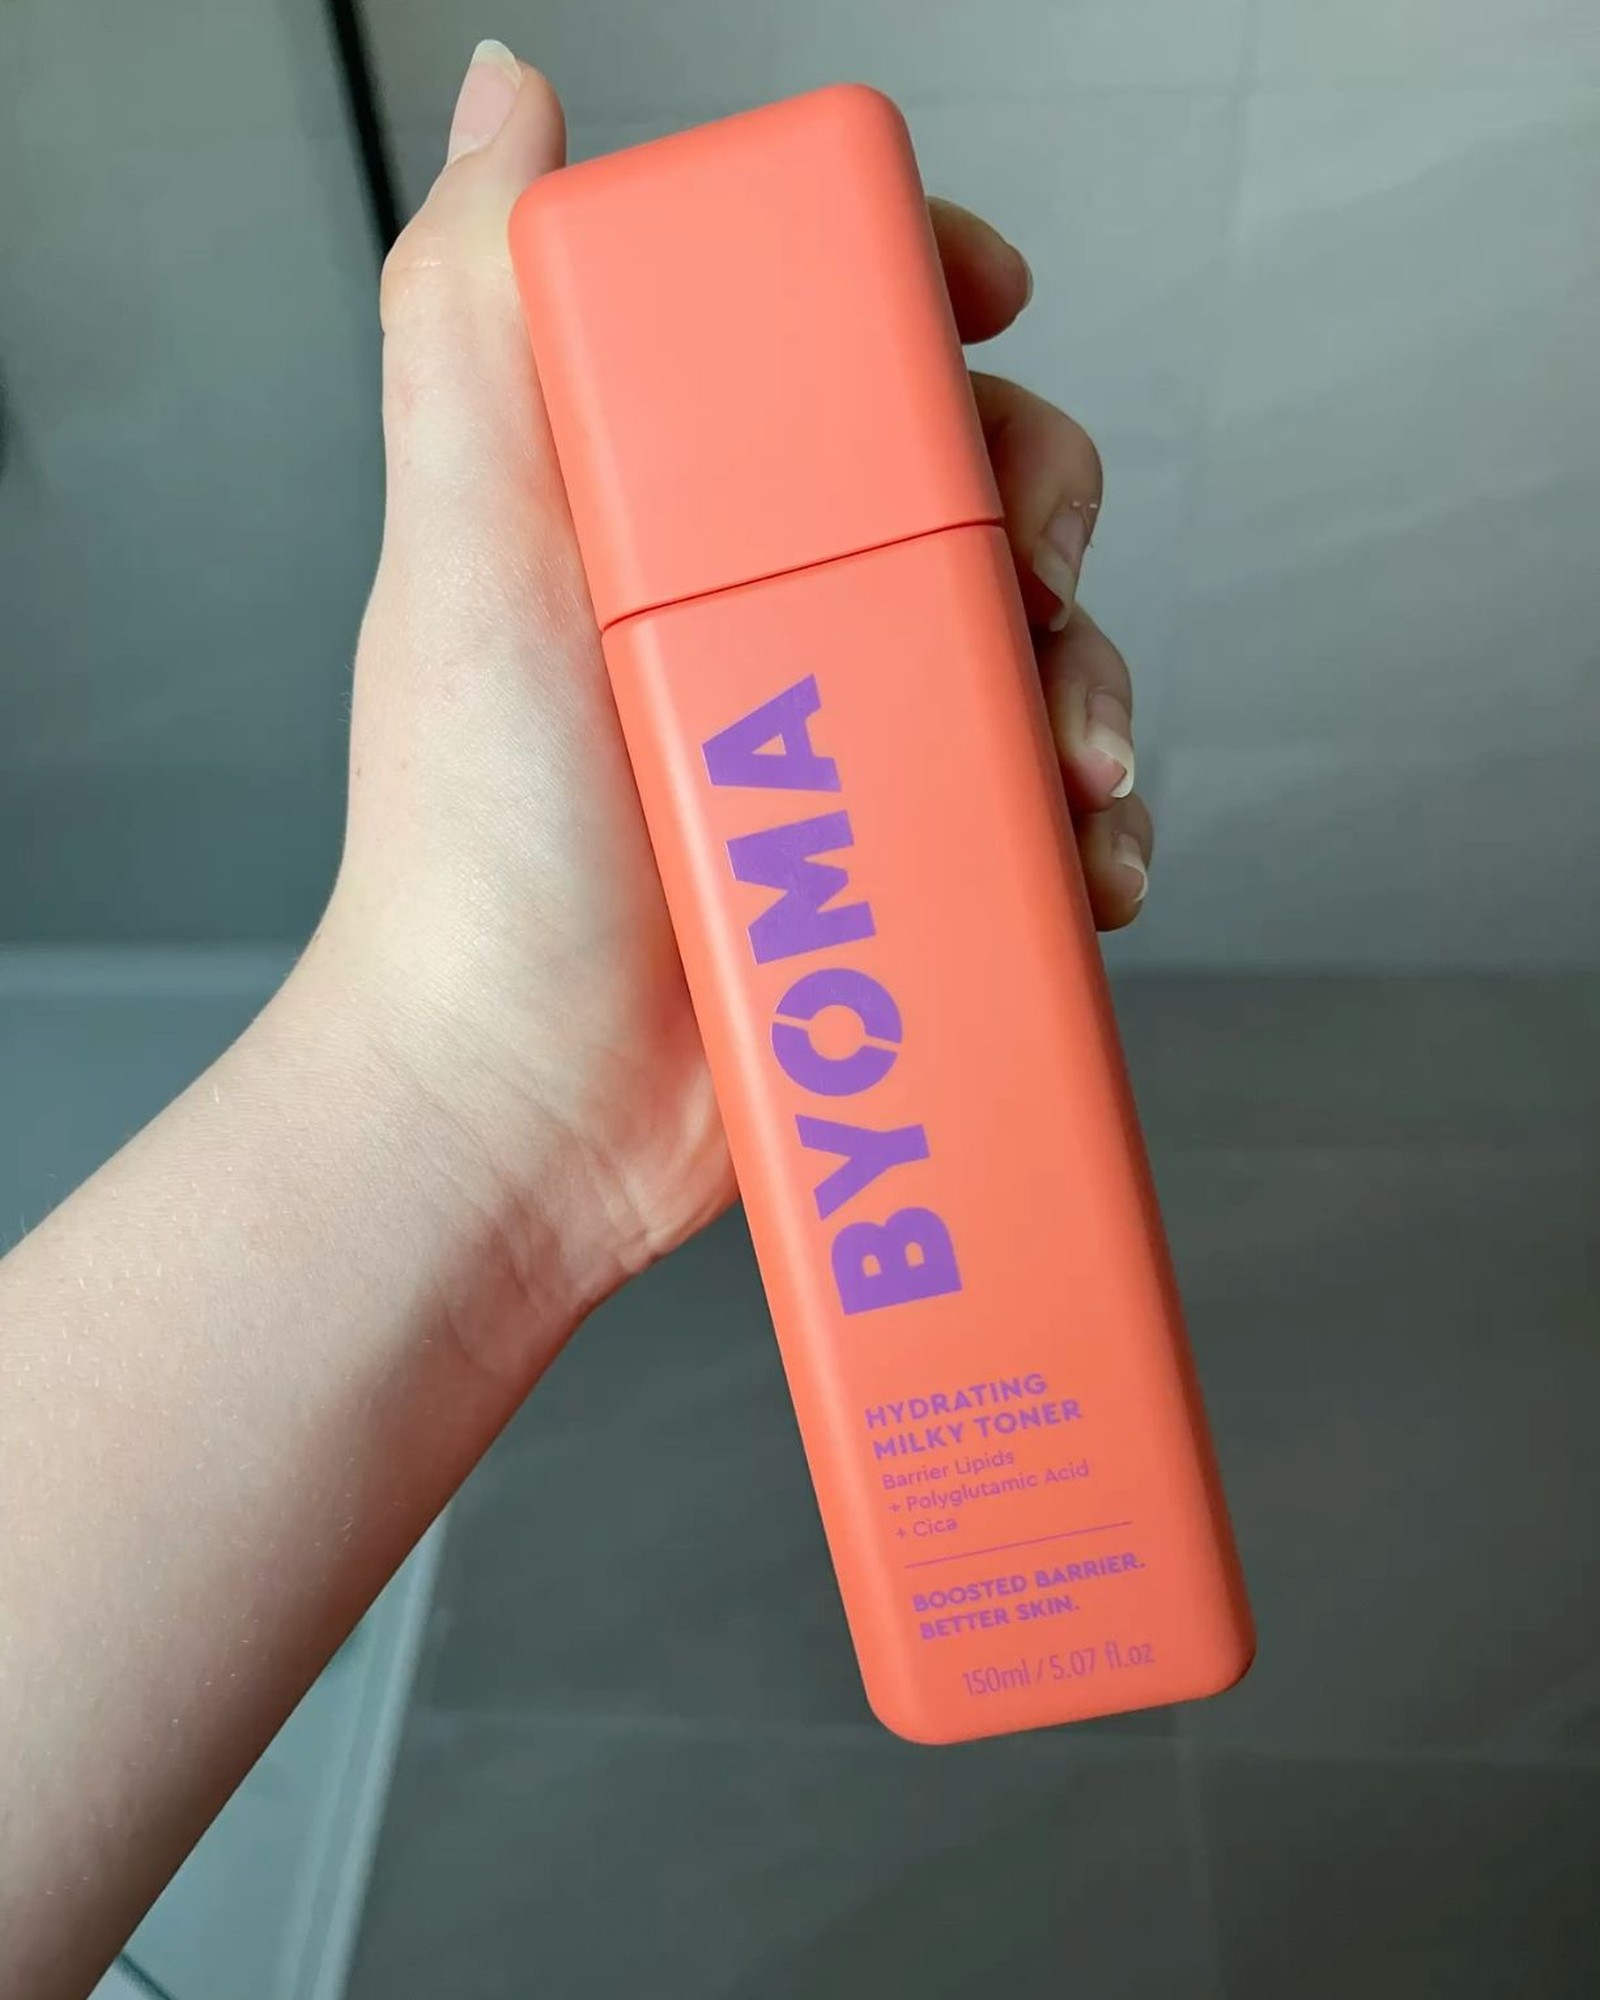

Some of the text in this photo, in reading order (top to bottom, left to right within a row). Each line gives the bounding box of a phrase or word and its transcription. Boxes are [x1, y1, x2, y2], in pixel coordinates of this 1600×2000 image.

[702, 673, 962, 1316] BYOMA
[865, 1373, 1047, 1429] HYDRATING
[872, 1399, 1083, 1461] MILKY TONER
[882, 1450, 1014, 1490] Barrier Lipids
[888, 1459, 1089, 1513] + Polyglutamic Acid
[895, 1517, 958, 1538] + Cica
[913, 1552, 1146, 1612] BOOSTED BARRIER.
[920, 1594, 1080, 1640] BETTER SKIN.
[962, 1641, 1156, 1696] 150ml / 5.07 fl.oz
